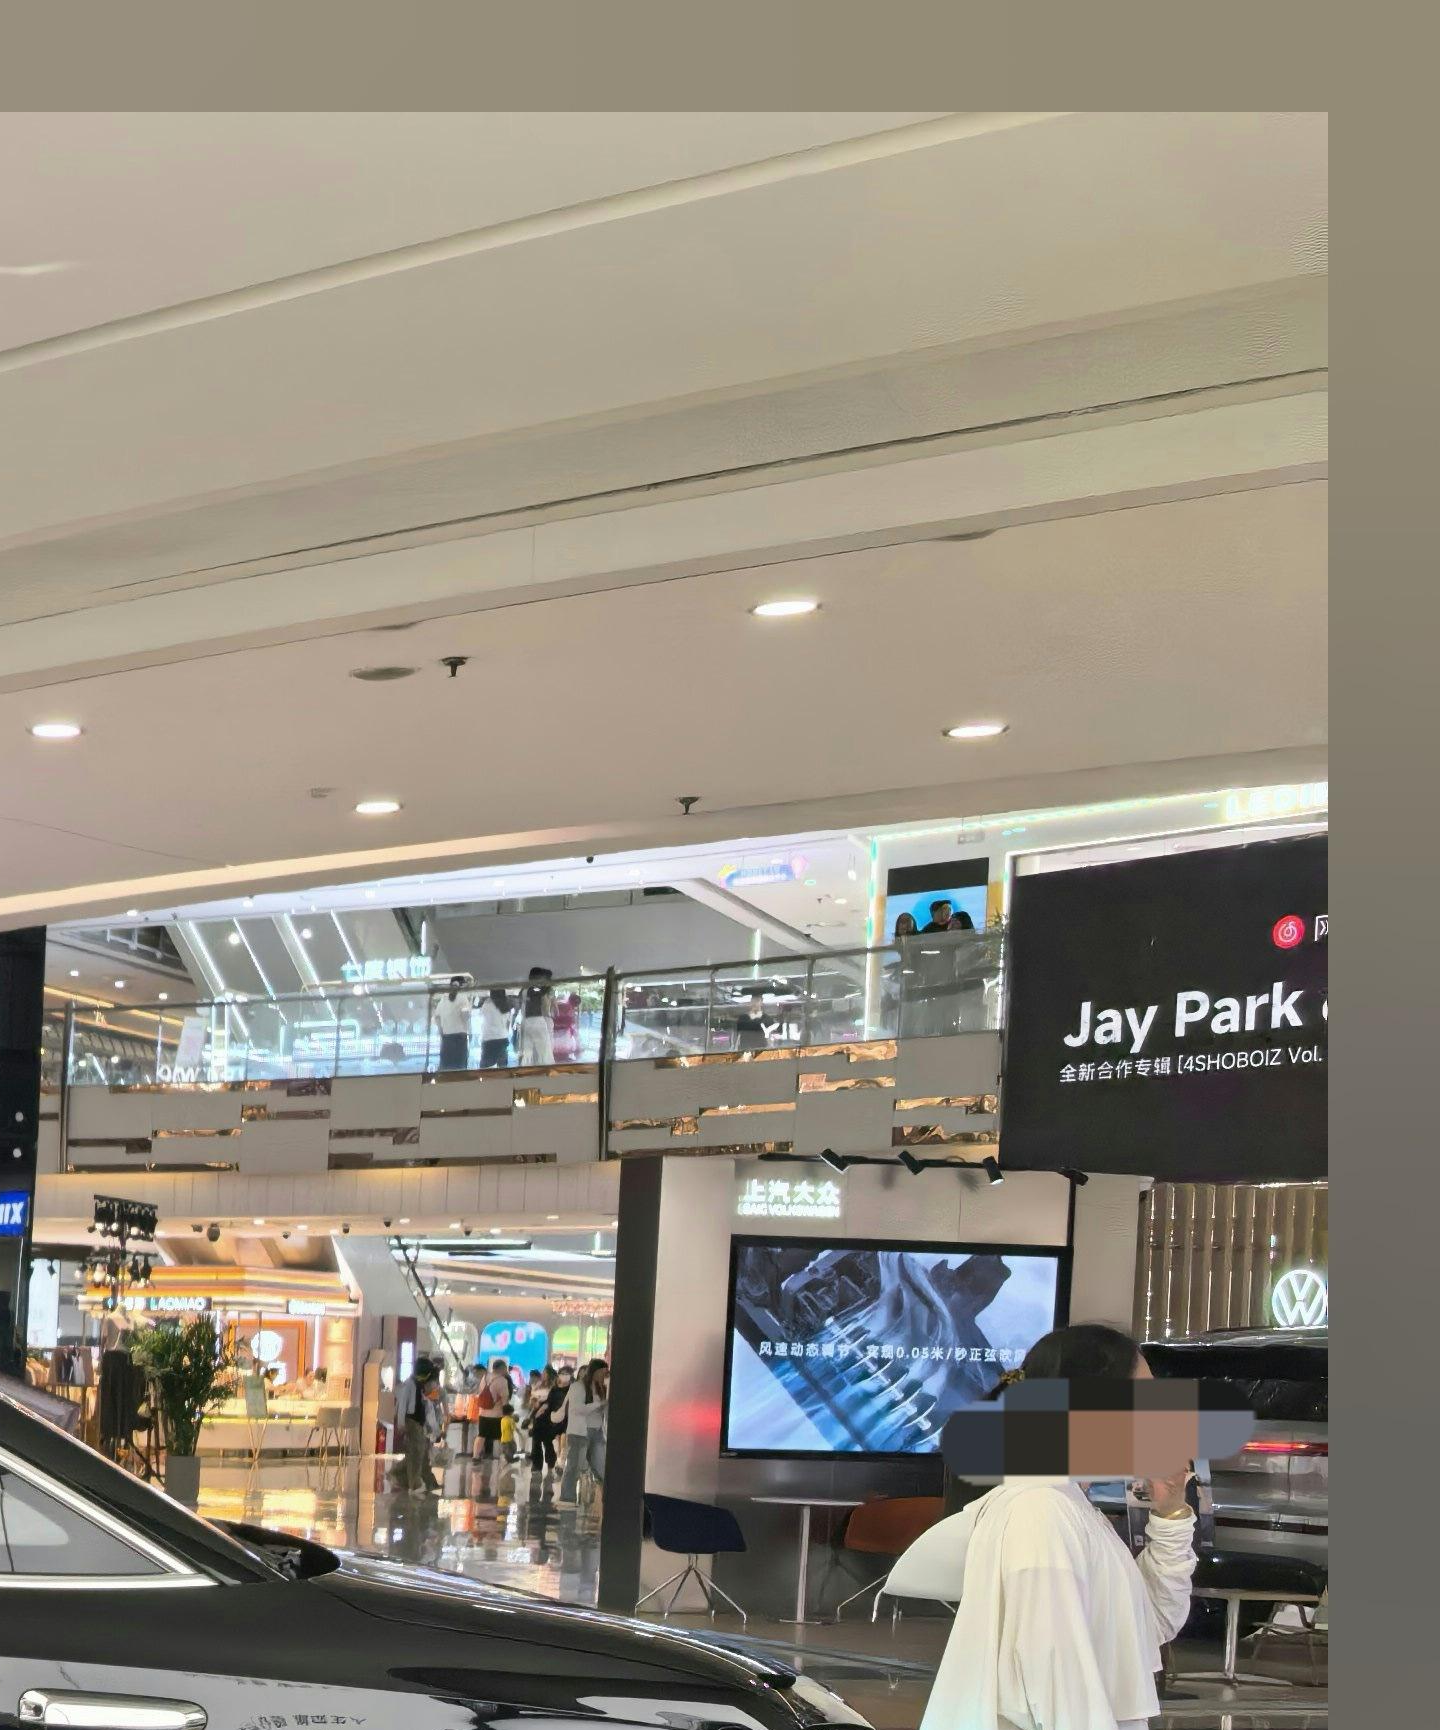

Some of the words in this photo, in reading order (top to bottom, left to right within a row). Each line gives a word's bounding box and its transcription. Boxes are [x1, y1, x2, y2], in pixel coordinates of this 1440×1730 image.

[1063, 1001, 1159, 1053] Jay
[1175, 981, 1304, 1038] Park
[1059, 1056, 1171, 1083] 全新合作专辑
[1288, 1045, 1323, 1064] Vol.
[740, 1179, 840, 1204] 上汽大众
